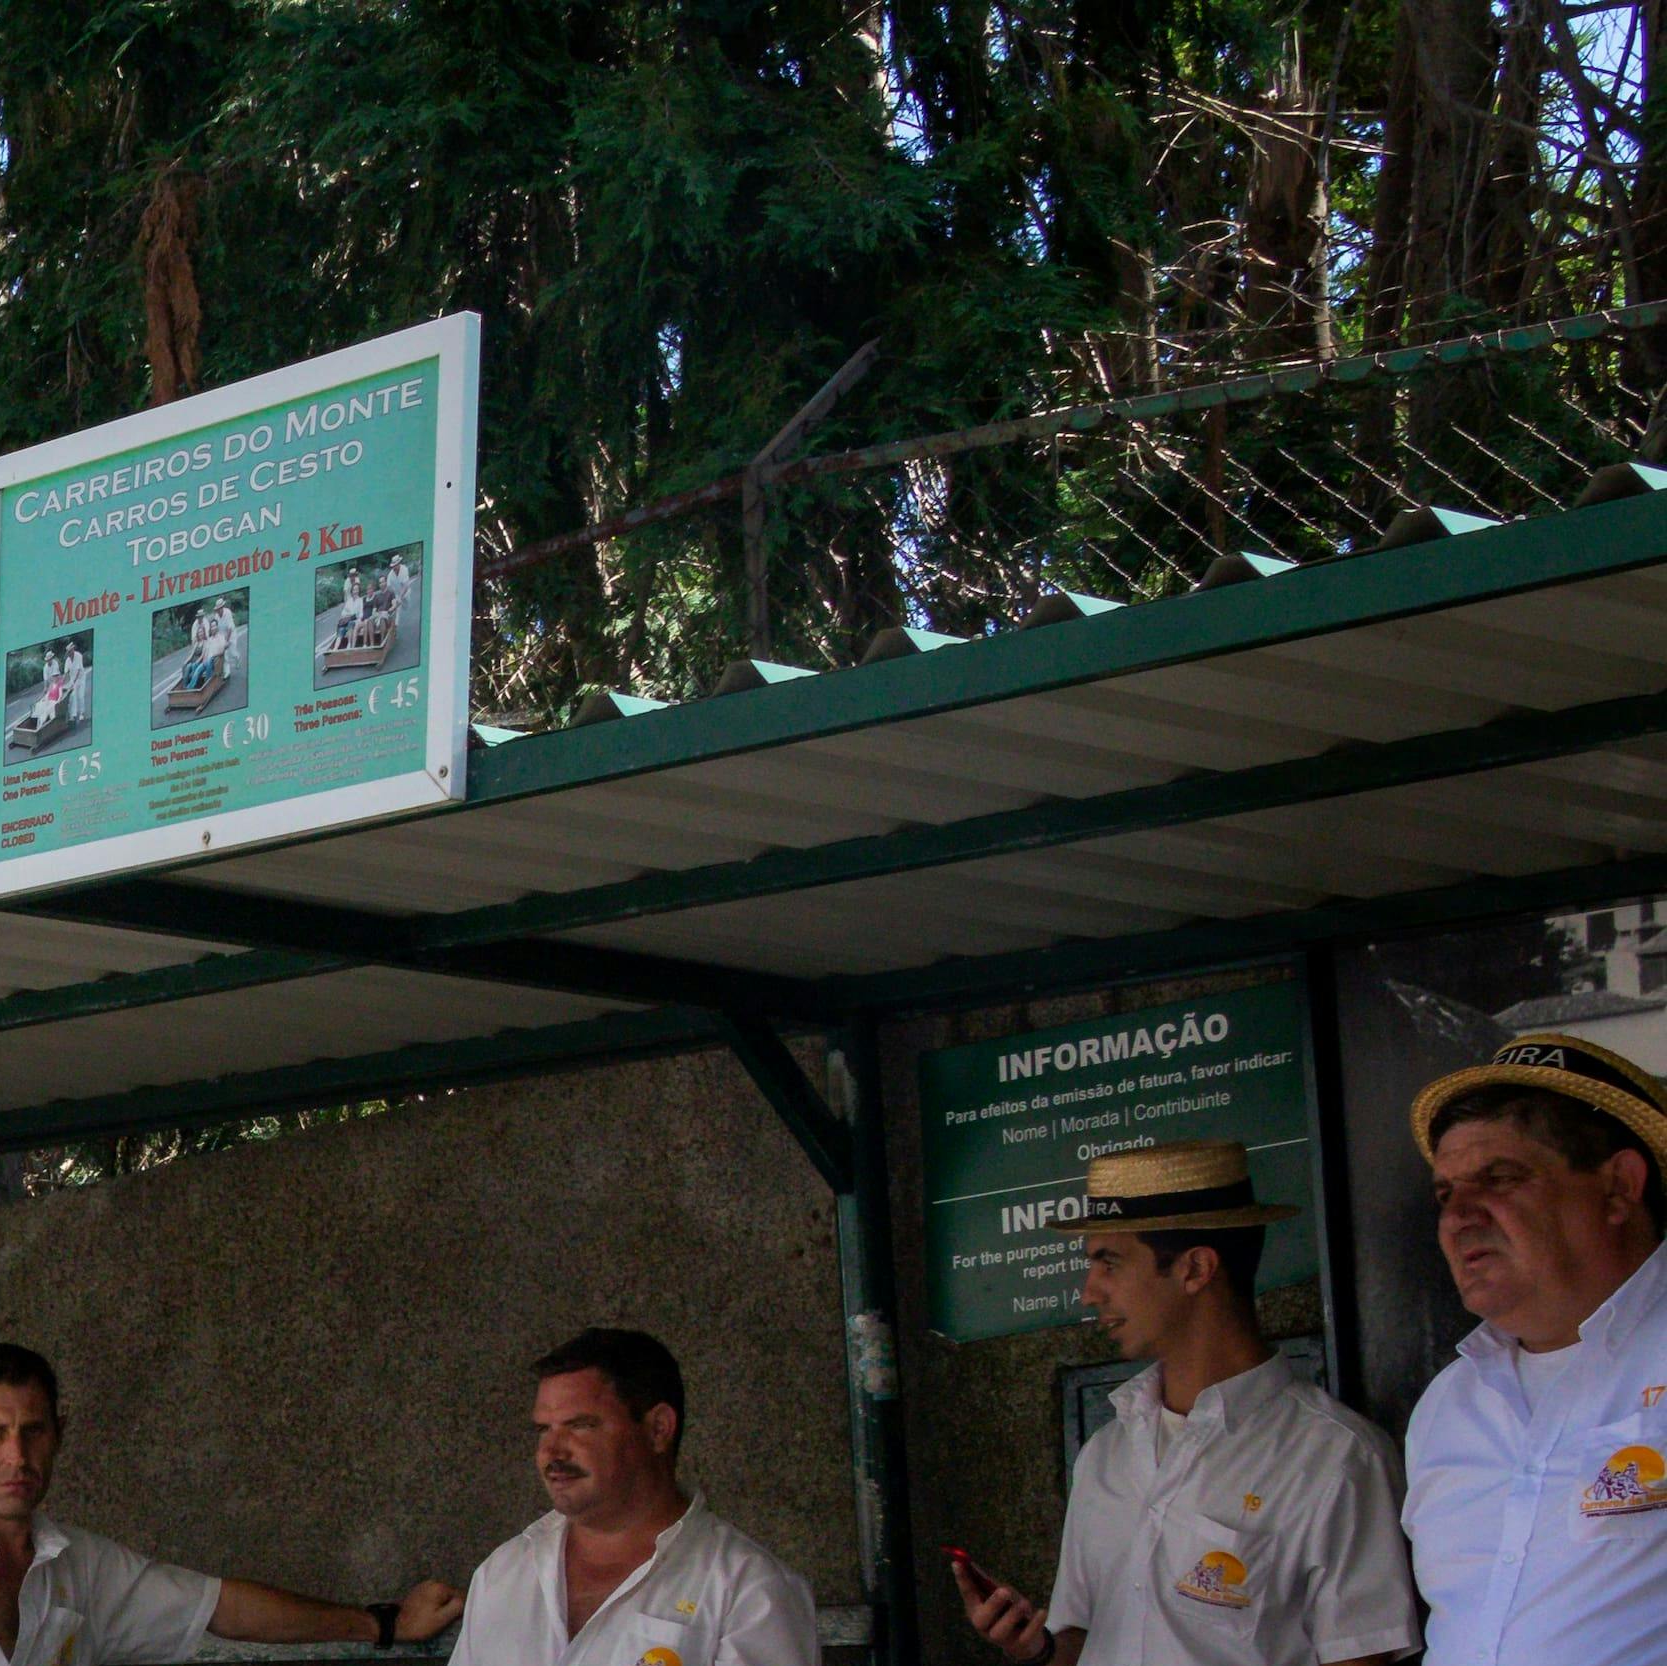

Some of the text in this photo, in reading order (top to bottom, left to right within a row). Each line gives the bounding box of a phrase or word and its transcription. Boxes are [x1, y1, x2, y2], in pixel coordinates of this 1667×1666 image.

[14, 379, 424, 524] CARREIROS DO MONTE
[58, 439, 364, 549] CARROS DE CESTO
[126, 502, 282, 567] TOBOGAN
[51, 591, 120, 629] Monte
[142, 549, 273, 604] Livramento
[297, 531, 310, 561] 2
[318, 523, 364, 555] Km
[390, 677, 419, 709] 45
[242, 712, 269, 745] 30
[77, 751, 101, 782] 25
[1, 812, 54, 834] ENCERRADO
[1, 832, 35, 849] CLOSED
[998, 1012, 1230, 1084] INFORMAÇÃO
[945, 1051, 1292, 1127] Para efeitos da emissão de fatura, favor indicar:
[1002, 1124, 1048, 1146] Nome
[1061, 1111, 1119, 1134] Morada
[1134, 1091, 1231, 1122] Contribuinte
[1001, 1195, 1088, 1234] INFO
[952, 1236, 1084, 1270] For the purpose of
[1023, 1260, 1066, 1280] report
[1013, 1295, 1058, 1313] Name
